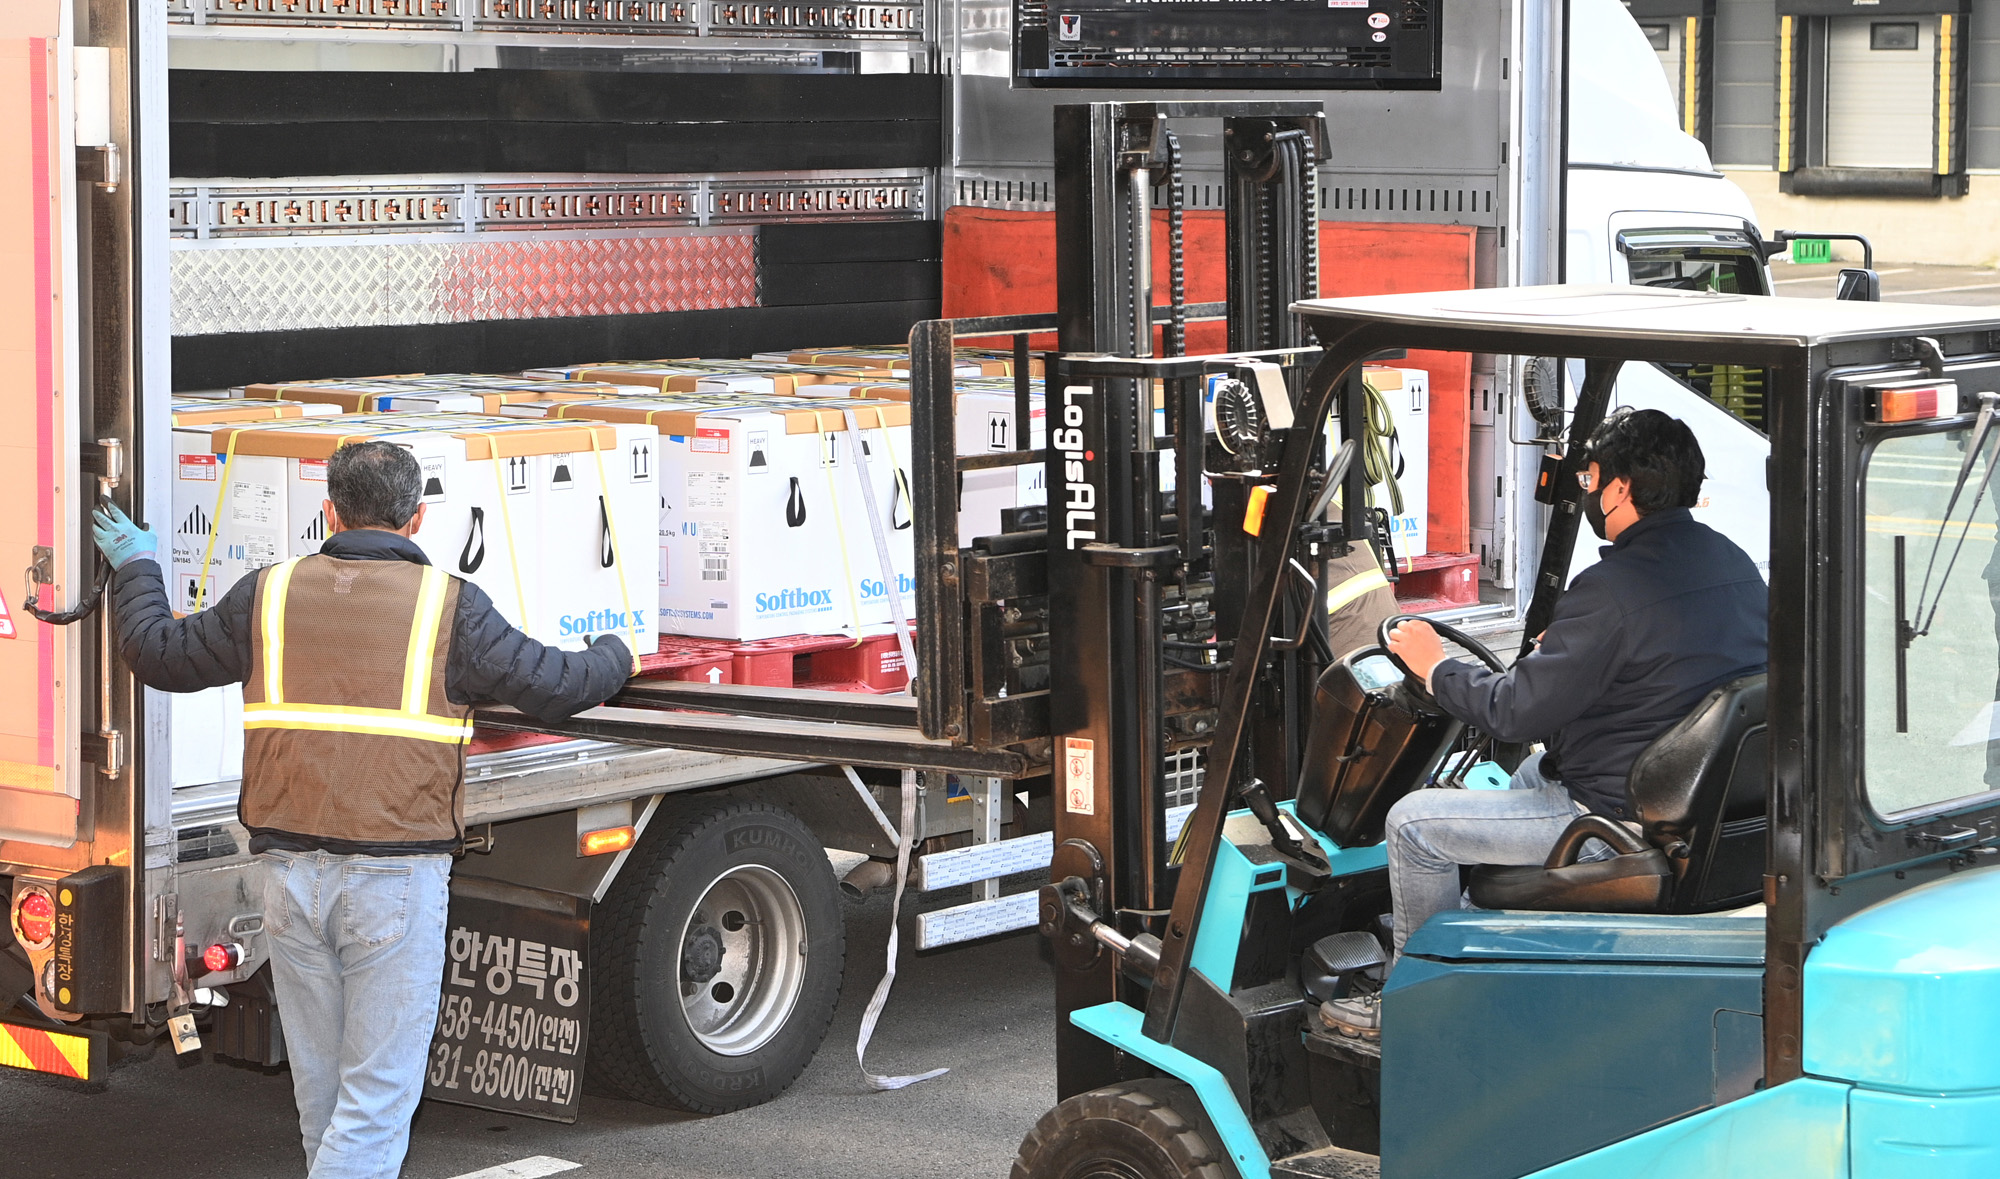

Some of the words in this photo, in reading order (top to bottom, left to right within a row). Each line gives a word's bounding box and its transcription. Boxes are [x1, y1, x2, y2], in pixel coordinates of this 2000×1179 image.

[172, 548, 181, 556] Dry
[172, 556, 191, 564] UN1845
[755, 587, 833, 613] Softbox
[559, 608, 645, 636] Softbox
[732, 828, 808, 867] KUMHO
[57, 913, 74, 981] 한성특장
[450, 926, 583, 1008] 한성특장
[426, 1042, 575, 1106] 31-8500(진천)
